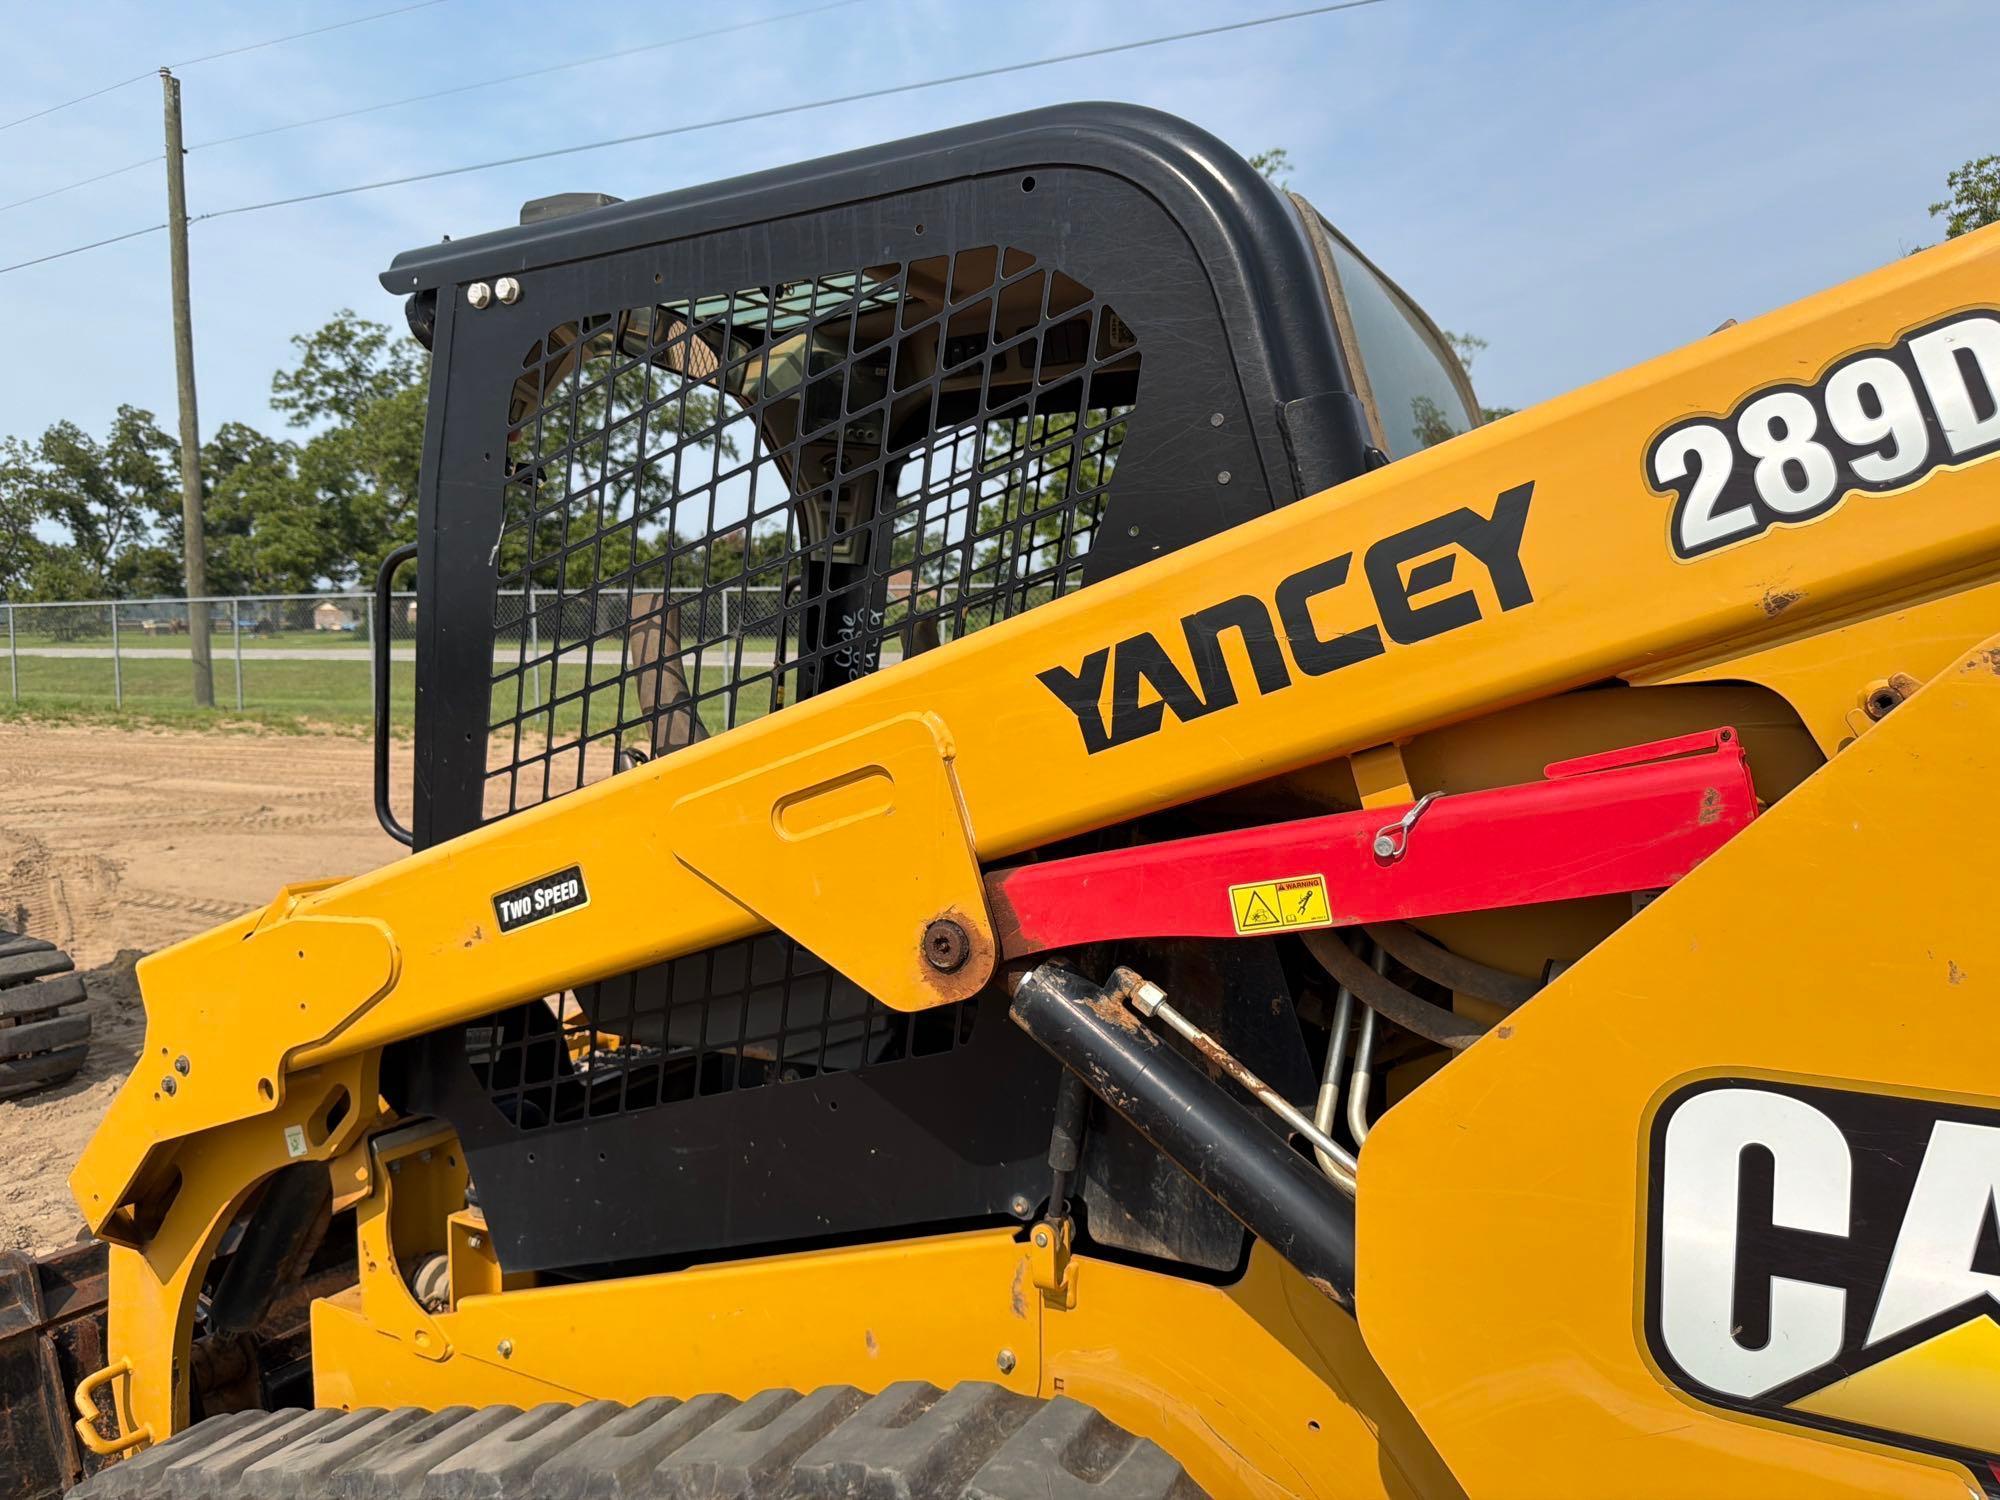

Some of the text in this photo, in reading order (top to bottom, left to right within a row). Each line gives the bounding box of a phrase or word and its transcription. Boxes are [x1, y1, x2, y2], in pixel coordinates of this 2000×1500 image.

[1654, 317, 2000, 550] 289D
[1035, 480, 1535, 755] YANCEY
[1286, 880, 1319, 890] WARNING
